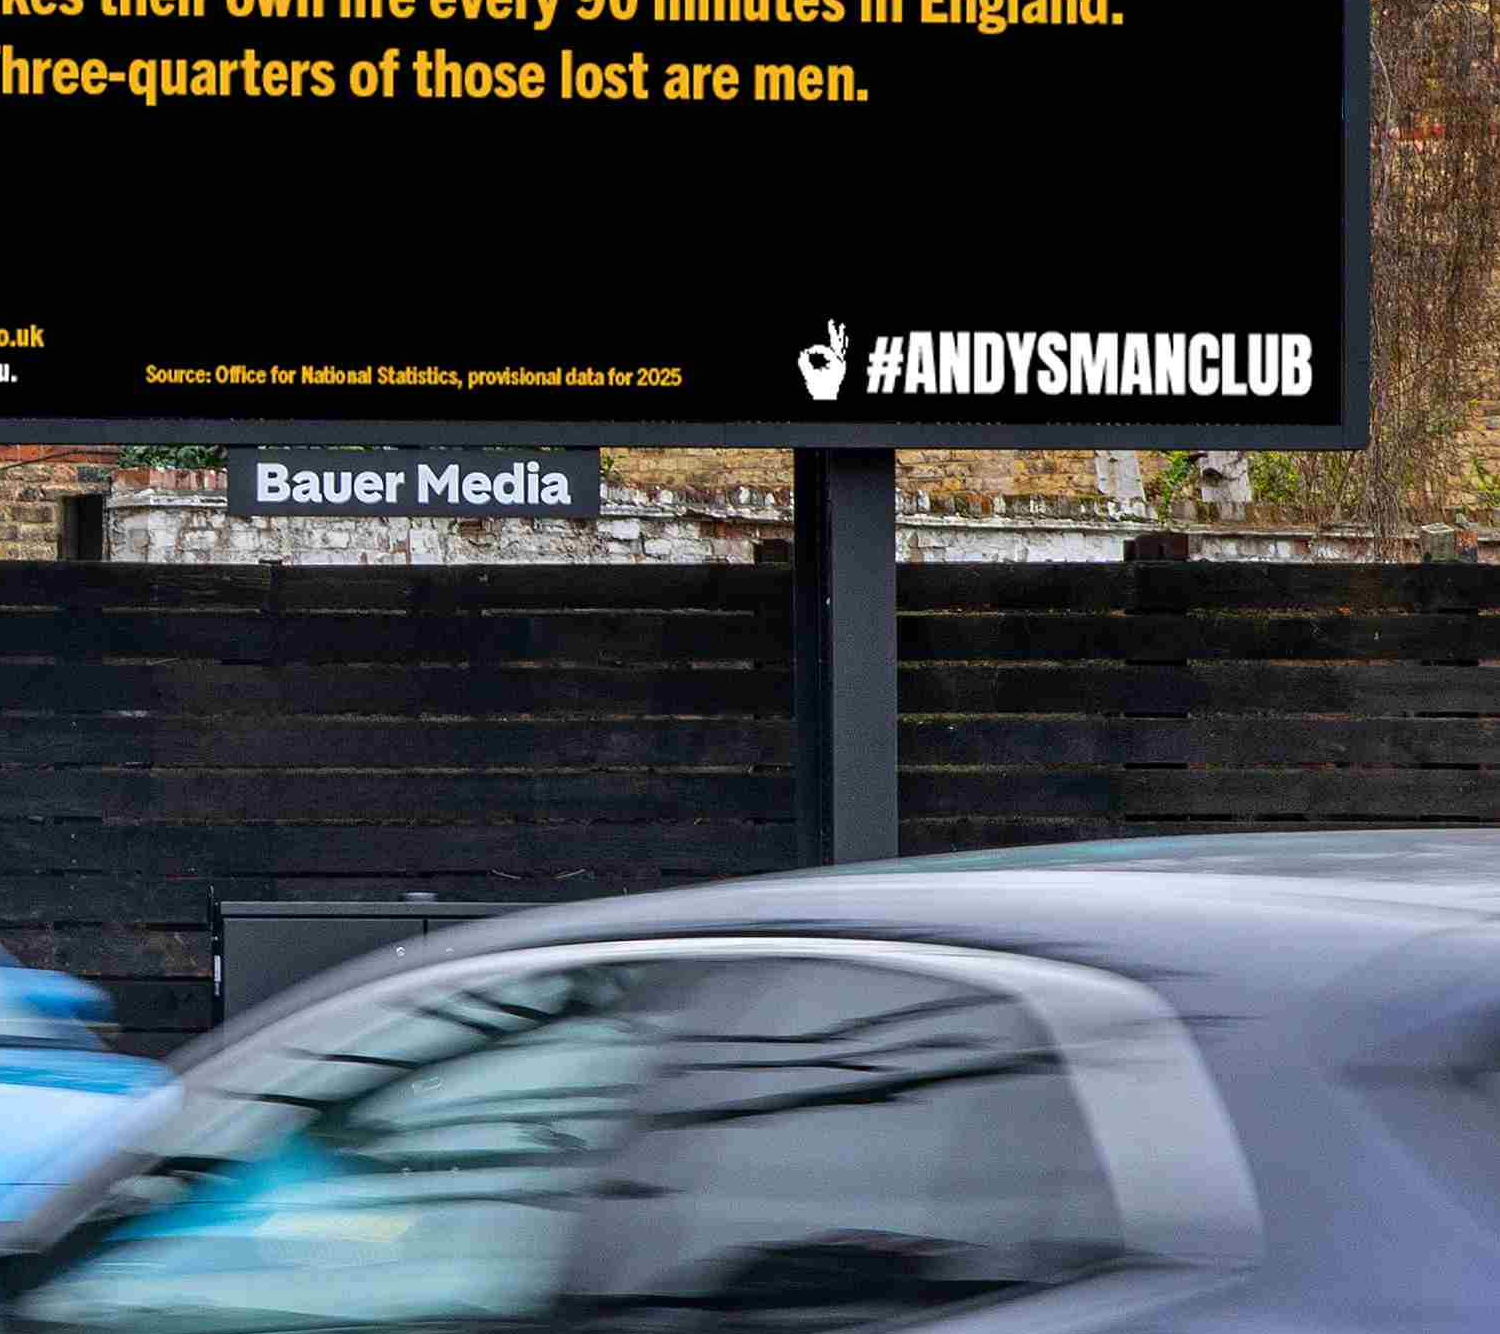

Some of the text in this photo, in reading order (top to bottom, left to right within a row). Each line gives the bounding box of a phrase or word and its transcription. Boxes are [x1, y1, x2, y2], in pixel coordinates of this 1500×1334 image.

[350, 47, 400, 98] of
[413, 47, 545, 99] those
[561, 48, 648, 100] lost
[664, 63, 739, 101] are
[754, 64, 869, 102] men.
[145, 364, 683, 390] Source: Office for National Statistics, provisional data for 2025
[866, 331, 1313, 397] #ANDYSMANCLUB
[256, 460, 572, 505] Bauer Media
